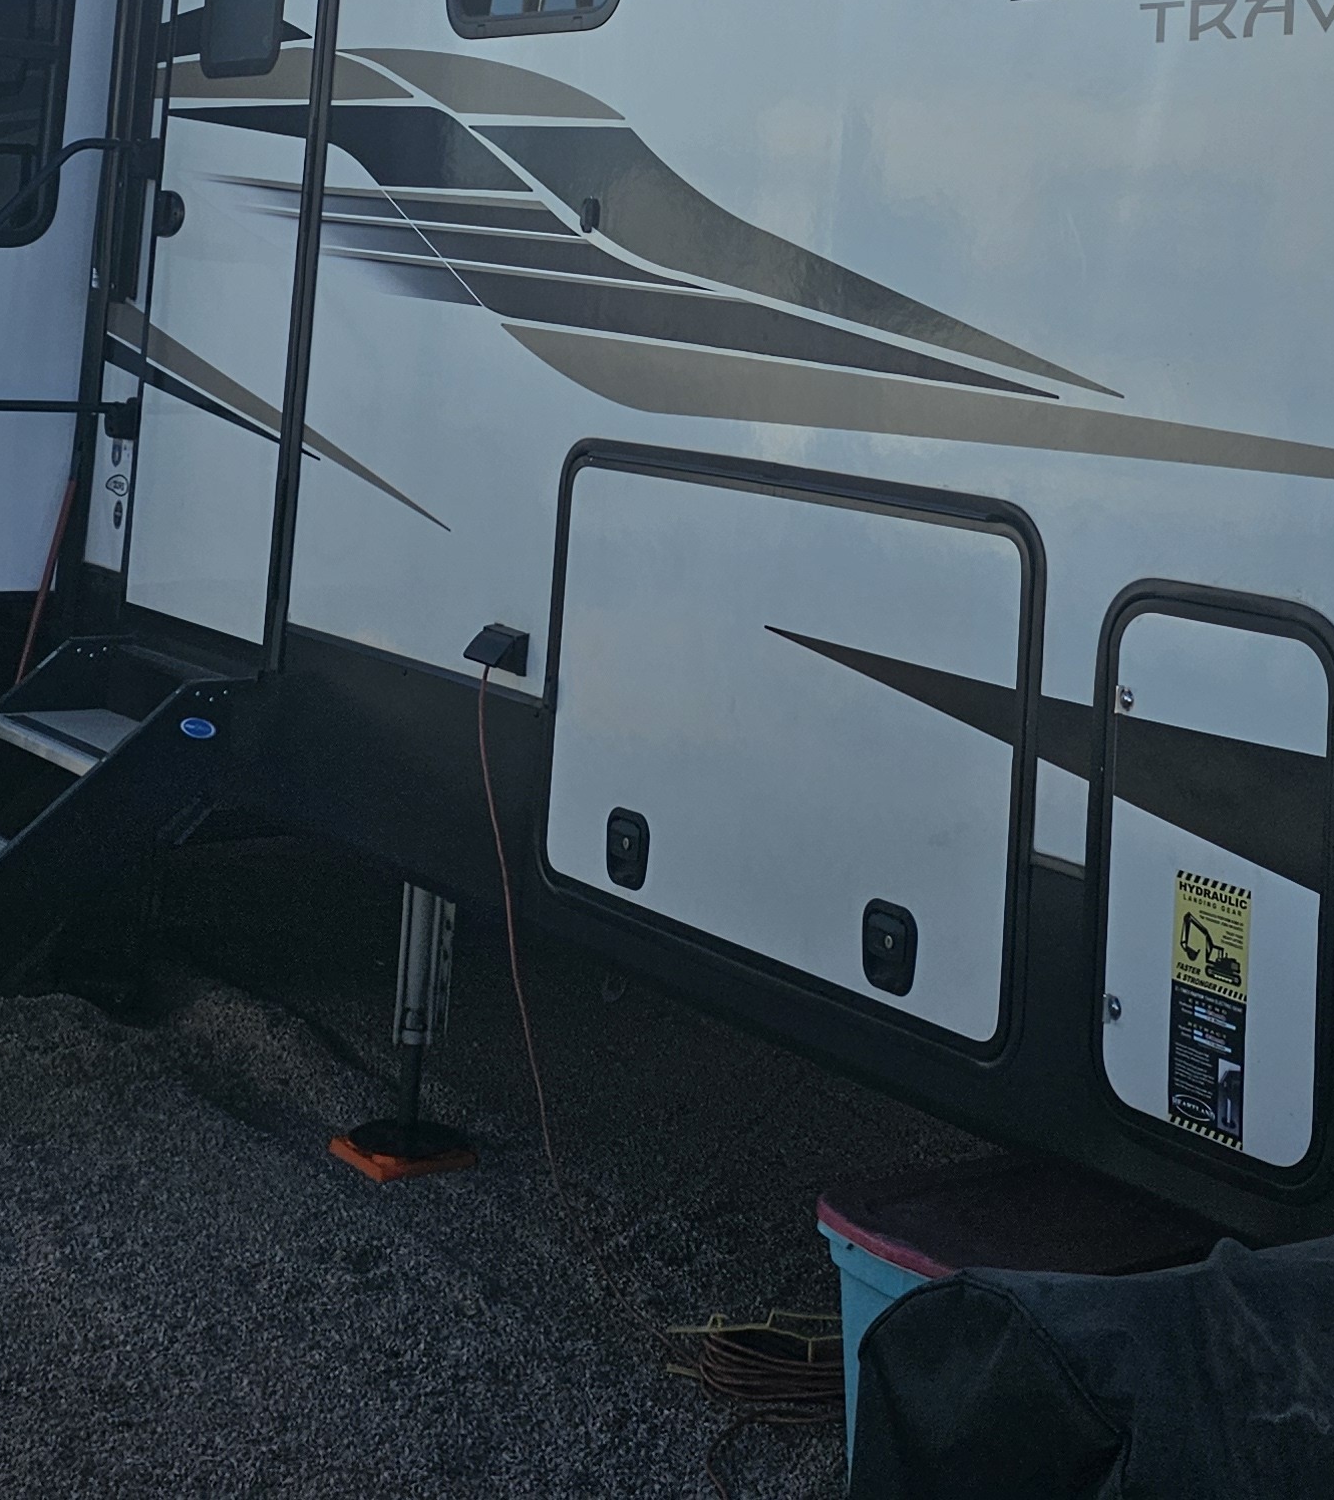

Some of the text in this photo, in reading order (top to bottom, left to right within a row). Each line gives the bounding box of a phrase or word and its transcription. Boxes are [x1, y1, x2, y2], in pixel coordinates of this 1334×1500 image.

[1179, 881, 1248, 910] HYDRAULIC
[1183, 894, 1242, 917] LANDING GEAR
[1176, 962, 1201, 975] FASTER
[1182, 973, 1218, 991] STRONGER
